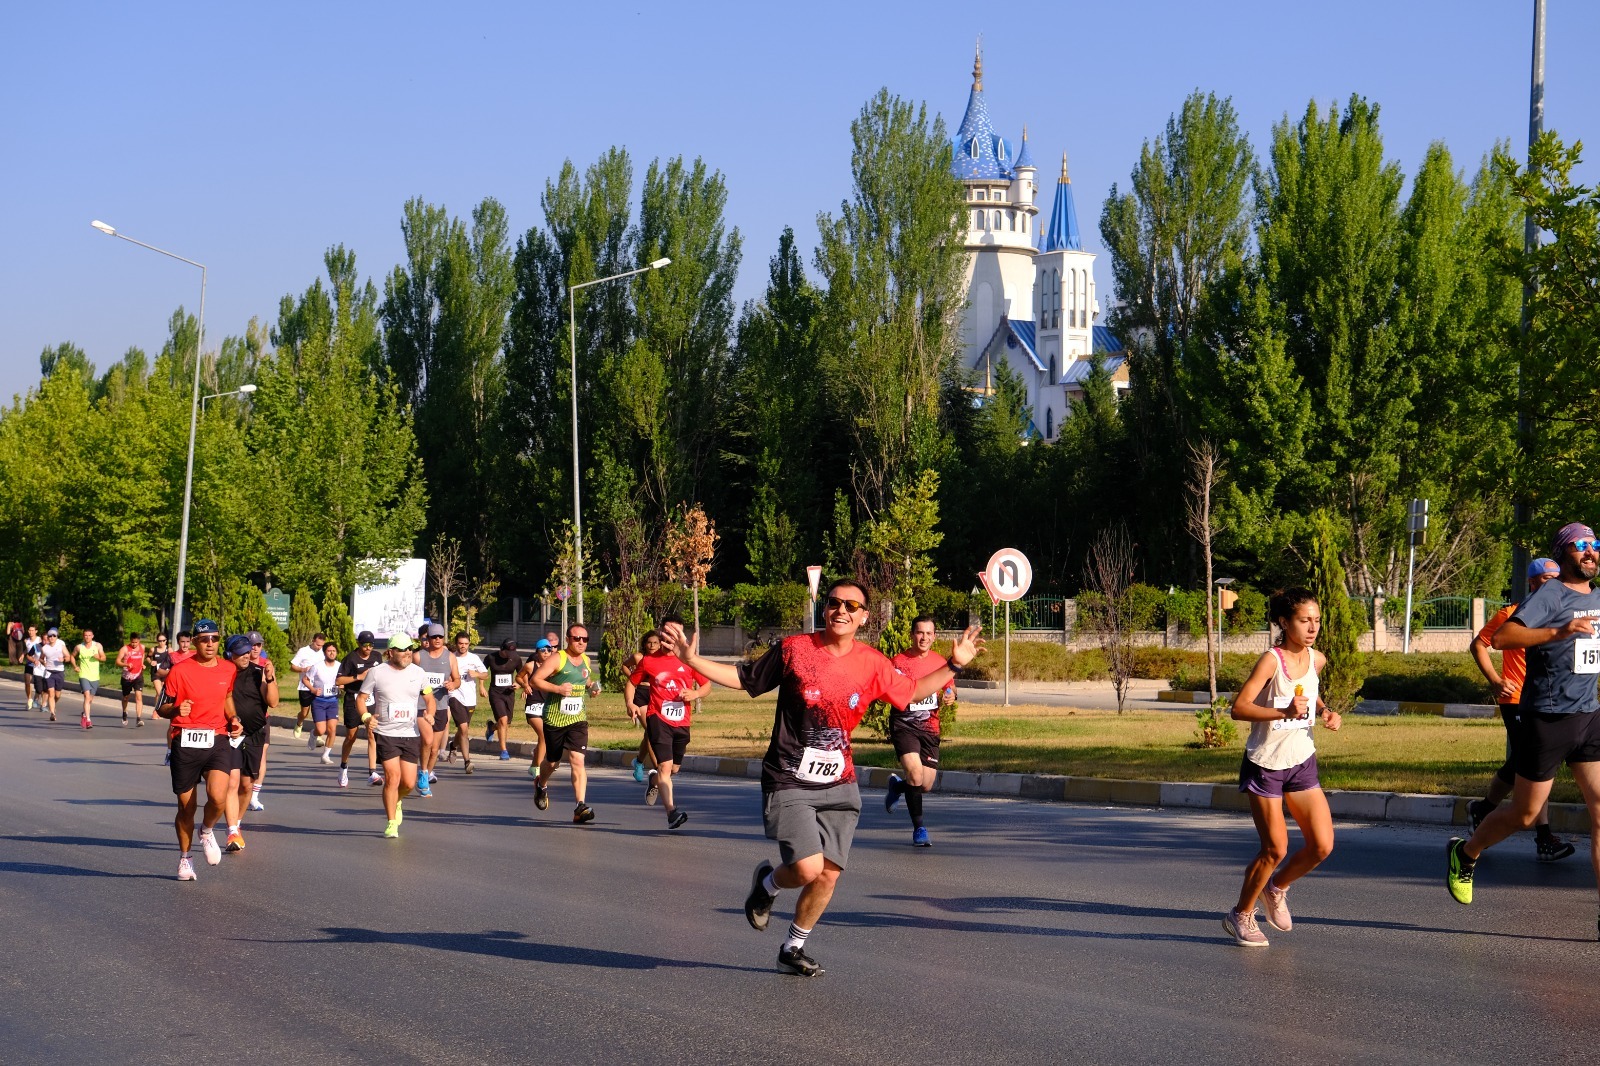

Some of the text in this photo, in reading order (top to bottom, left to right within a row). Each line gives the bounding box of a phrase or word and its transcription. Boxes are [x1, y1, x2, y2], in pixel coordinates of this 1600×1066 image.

[1574, 610, 1586, 618] RUN
[394, 710, 409, 718] 201
[666, 708, 682, 716] 1710
[187, 732, 208, 742] 1071
[808, 760, 839, 776] 1782
